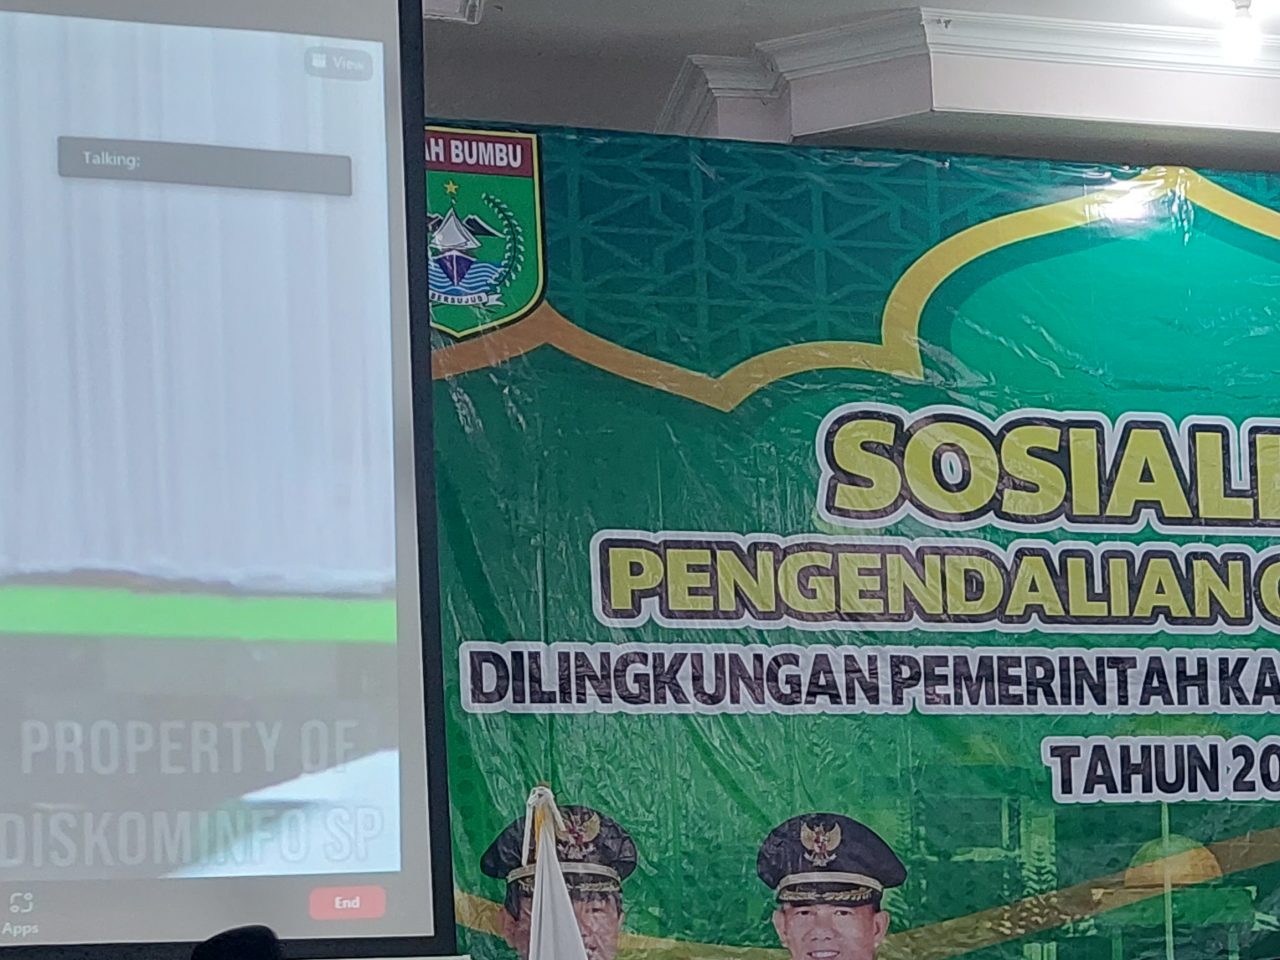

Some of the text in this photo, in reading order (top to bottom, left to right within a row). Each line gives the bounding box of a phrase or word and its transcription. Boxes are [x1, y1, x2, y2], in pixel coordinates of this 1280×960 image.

[82, 151, 140, 170] Talking:
[450, 140, 521, 168] BUMBU
[602, 540, 1251, 626] PENGENDALIAN
[469, 650, 880, 706] DILINGKUNGAN
[892, 654, 1215, 706] PEMERINTAH
[21, 719, 359, 774] PROPERTY OF
[1050, 743, 1219, 795] TAHUN
[0, 807, 384, 868] DISKOMINFO SP
[335, 896, 360, 909] End
[2, 922, 39, 937] Apps
